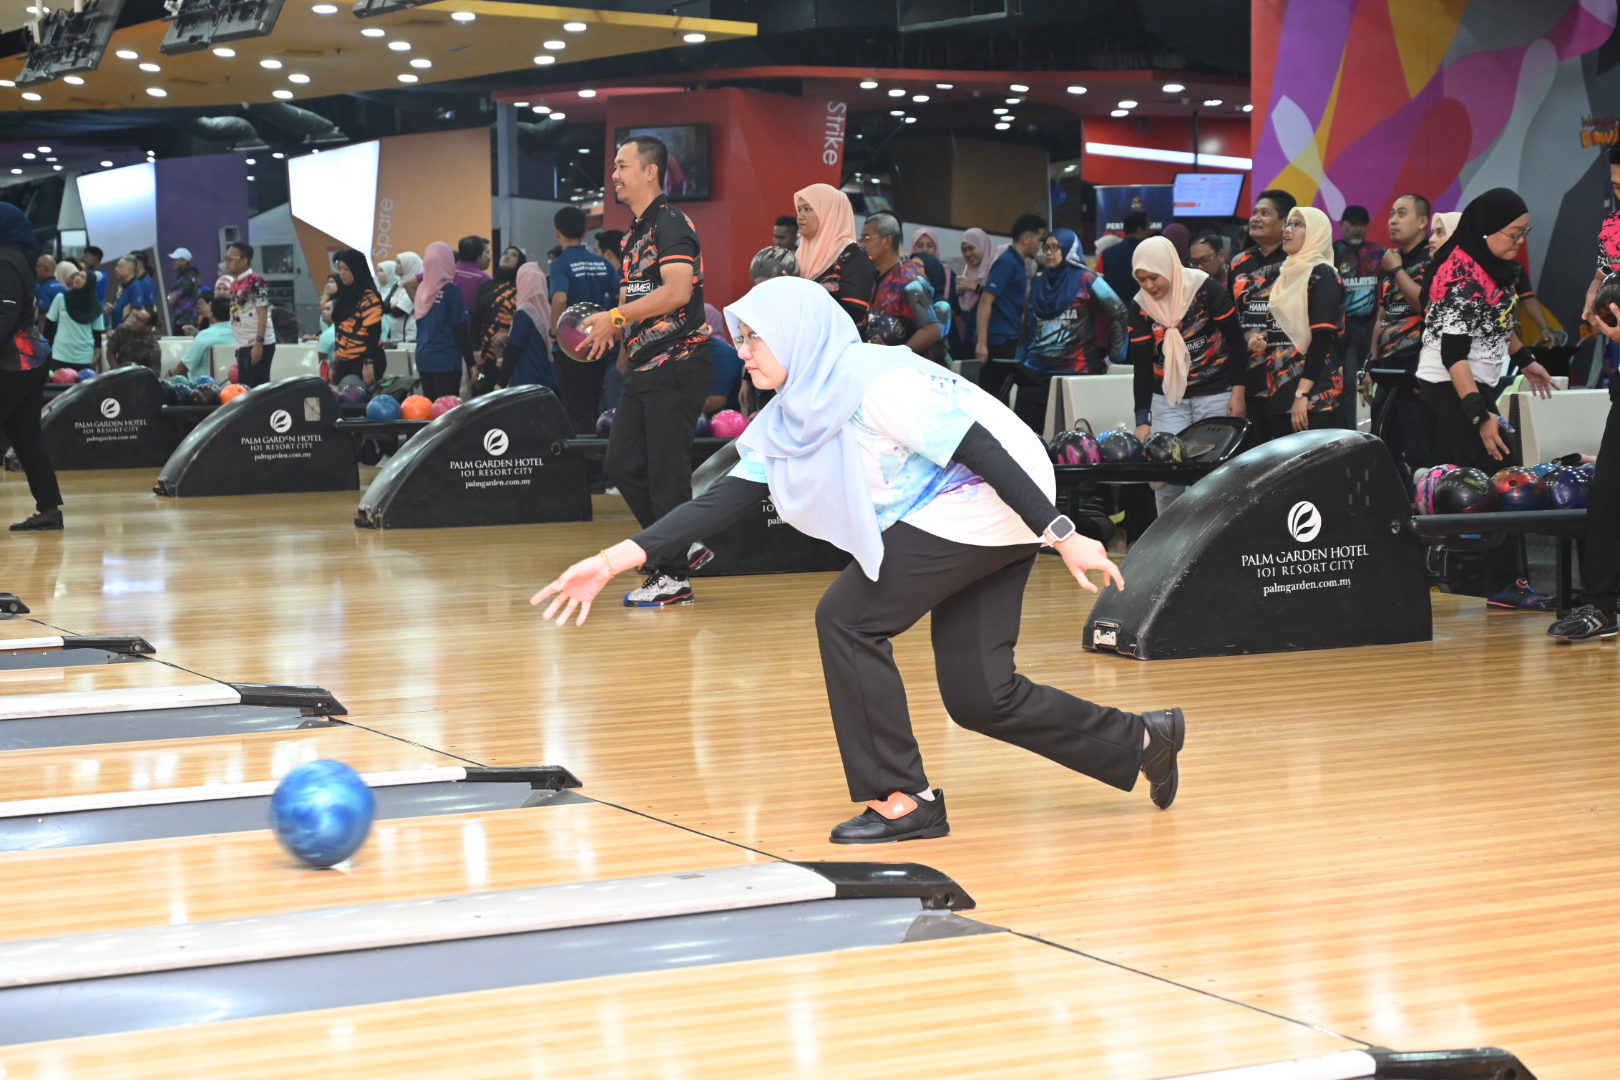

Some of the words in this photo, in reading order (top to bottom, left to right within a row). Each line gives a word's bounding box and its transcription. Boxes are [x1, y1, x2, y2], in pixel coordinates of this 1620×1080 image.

[823, 101, 847, 166] Strike
[371, 198, 394, 259] Spare
[74, 421, 93, 429] PALM
[93, 420, 123, 428] GARDEN
[241, 437, 261, 445] PALM
[297, 434, 322, 442] HOTEL
[254, 452, 312, 461] palmgarden.com.my
[450, 460, 474, 469] PALM
[474, 459, 513, 468] GARDEN
[514, 458, 544, 467] HOTEL
[478, 468, 512, 477] RESORT
[513, 467, 533, 475] CITY
[465, 479, 531, 489] palmgarden.com.my
[1241, 553, 1274, 567] PALM
[1275, 548, 1328, 564] GARDEN
[1330, 544, 1369, 558] HOTEL
[1281, 562, 1327, 576] RESORT
[1329, 559, 1355, 571] CITY
[1263, 578, 1351, 597] palmgarden.com.my
